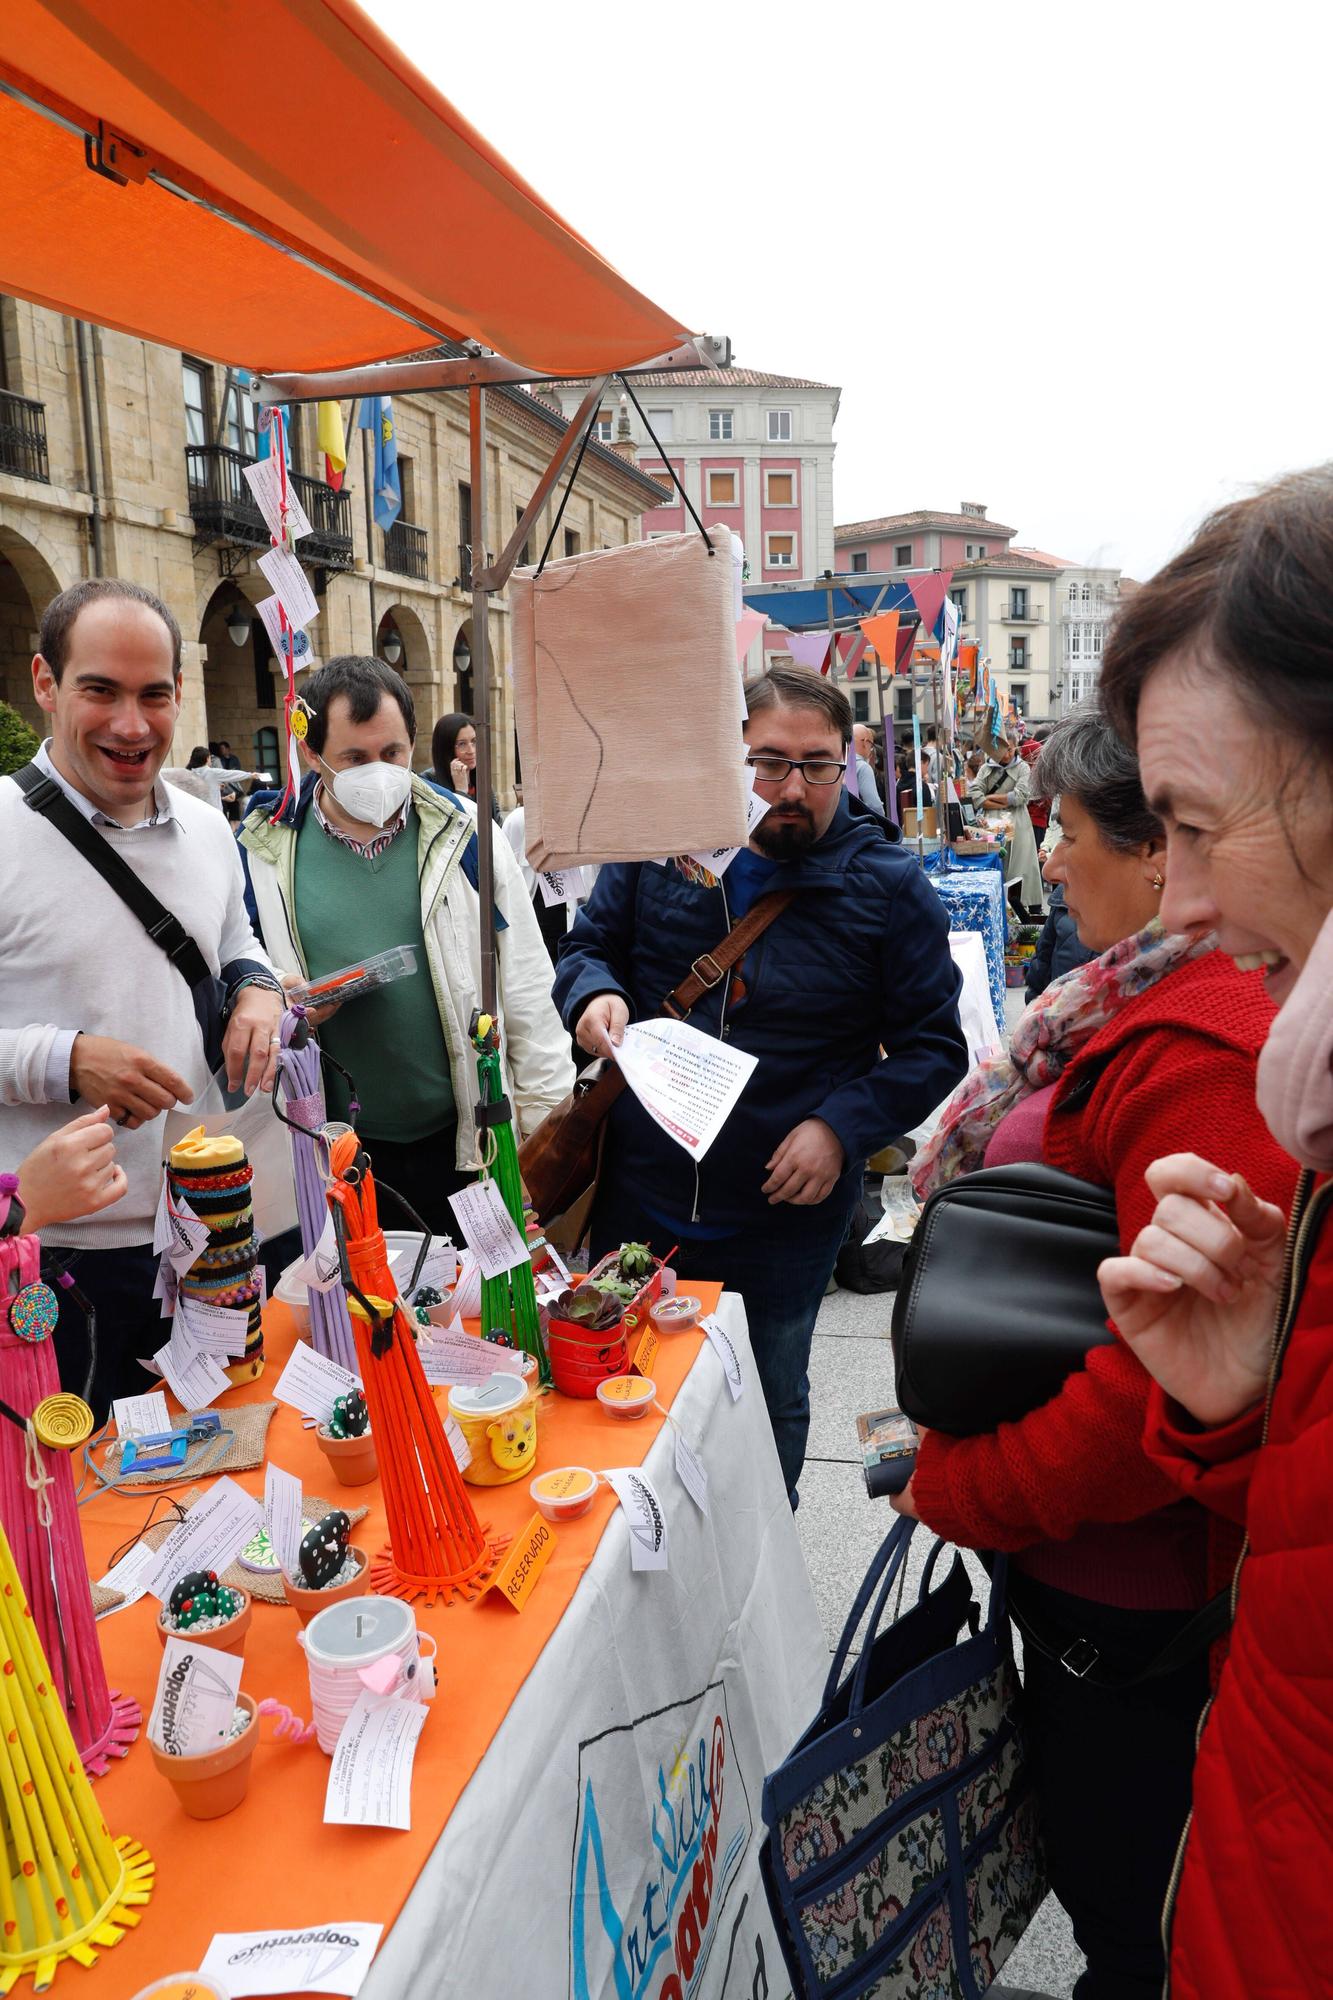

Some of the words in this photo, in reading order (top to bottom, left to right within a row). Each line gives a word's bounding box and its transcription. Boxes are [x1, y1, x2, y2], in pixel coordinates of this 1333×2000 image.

[149, 1559, 171, 1587] PRODUCTO
[167, 1534, 190, 1561] ARTESANO
[204, 1492, 228, 1518] EXCLUSIVO
[626, 1474, 663, 1552] cooperativ@
[506, 1525, 549, 1599] RESERVADO
[162, 1654, 192, 1756] cooperativ@
[344, 1768, 355, 1795] ARTESANO
[349, 1737, 362, 1762] DISEÑO
[227, 1927, 360, 1965] cooperativ@
